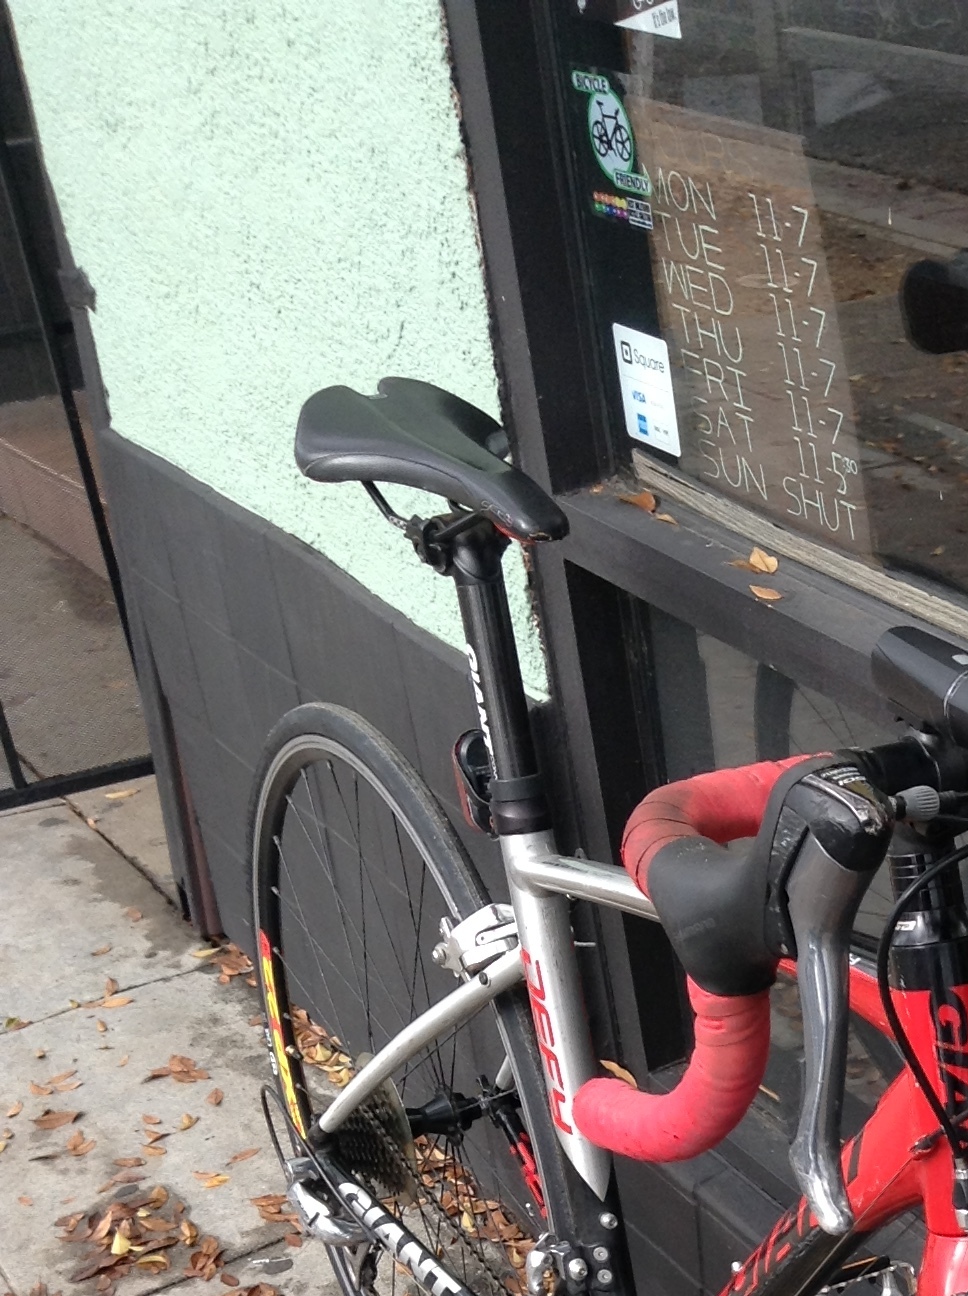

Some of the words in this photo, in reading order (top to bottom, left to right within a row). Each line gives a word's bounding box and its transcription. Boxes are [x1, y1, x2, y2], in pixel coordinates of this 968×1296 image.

[575, 73, 608, 95] BICYCLE
[615, 171, 649, 192] FRIENDLY
[642, 163, 717, 221] MON
[653, 209, 726, 271] TUE
[661, 256, 734, 316] WED
[633, 348, 665, 374] Square
[672, 302, 743, 363] THU
[680, 348, 753, 412] FRI
[693, 395, 755, 453] SAT
[699, 438, 768, 501] SUN
[782, 476, 857, 541] SHUT
